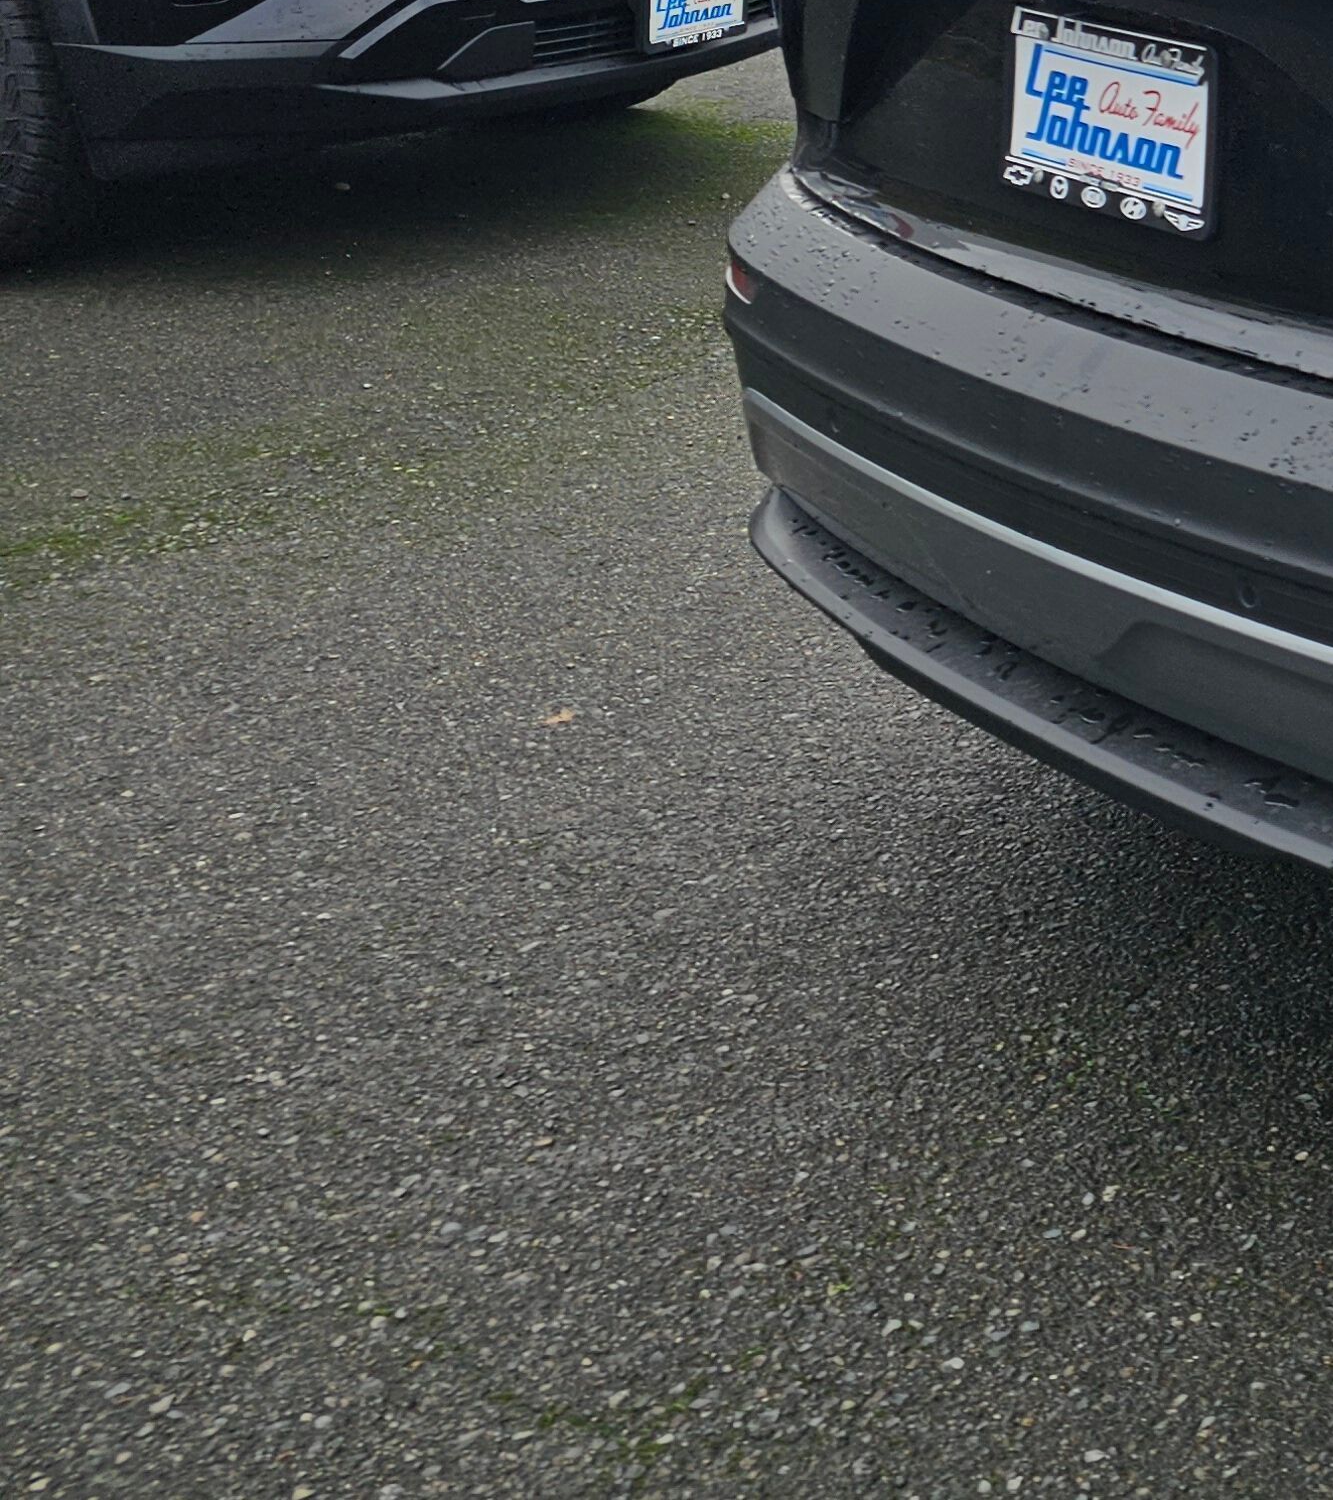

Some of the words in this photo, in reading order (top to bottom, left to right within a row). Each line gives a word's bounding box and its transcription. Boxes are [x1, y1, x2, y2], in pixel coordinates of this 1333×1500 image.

[657, 3, 733, 30] Johnson
[672, 33, 700, 48] SINCE
[701, 29, 722, 42] 1933
[1025, 43, 1089, 108] Lee
[1098, 81, 1138, 120] Auto
[1142, 89, 1200, 150] Family
[1025, 100, 1184, 180] Johnson
